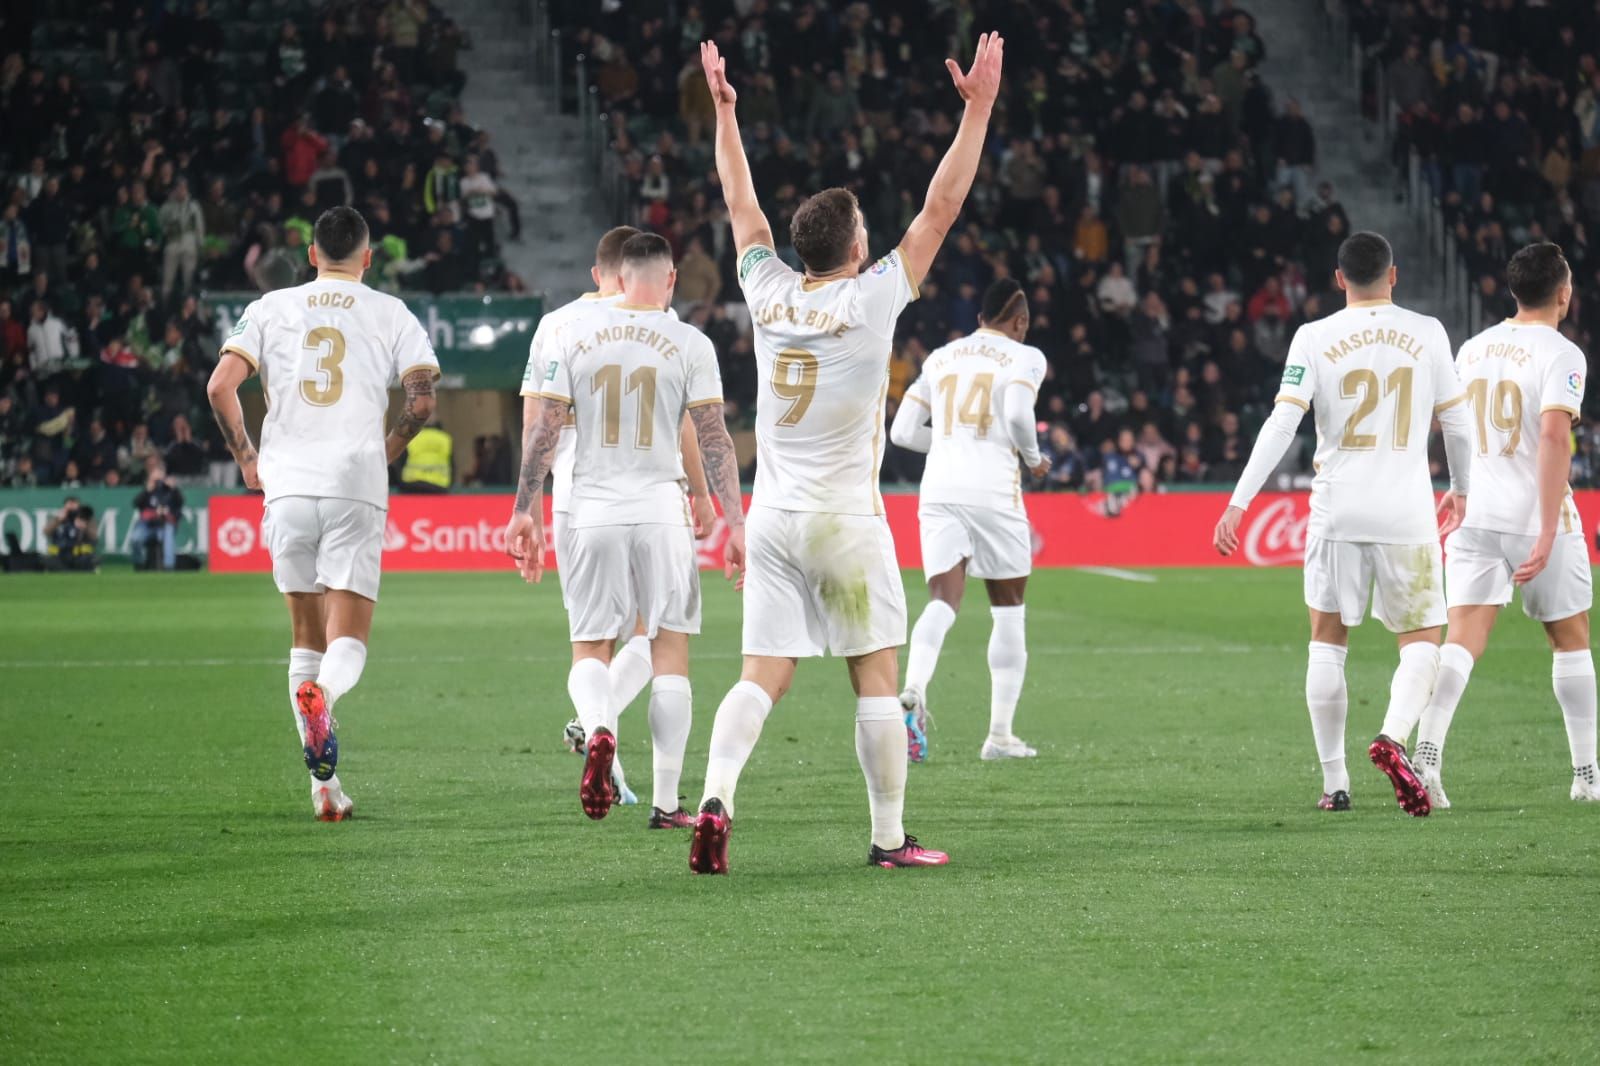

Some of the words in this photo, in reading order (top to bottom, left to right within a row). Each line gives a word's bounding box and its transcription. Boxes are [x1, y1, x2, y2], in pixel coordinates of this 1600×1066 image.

[307, 292, 355, 309] ROCO
[300, 326, 346, 407] 3
[595, 325, 680, 361] MORENTE
[1323, 328, 1423, 364] MASCARELL
[1485, 342, 1532, 368] PONCE
[591, 364, 657, 450] 11
[770, 347, 819, 428] 9
[938, 372, 994, 440] 14
[1338, 366, 1413, 451] 21
[1467, 378, 1523, 457] 19
